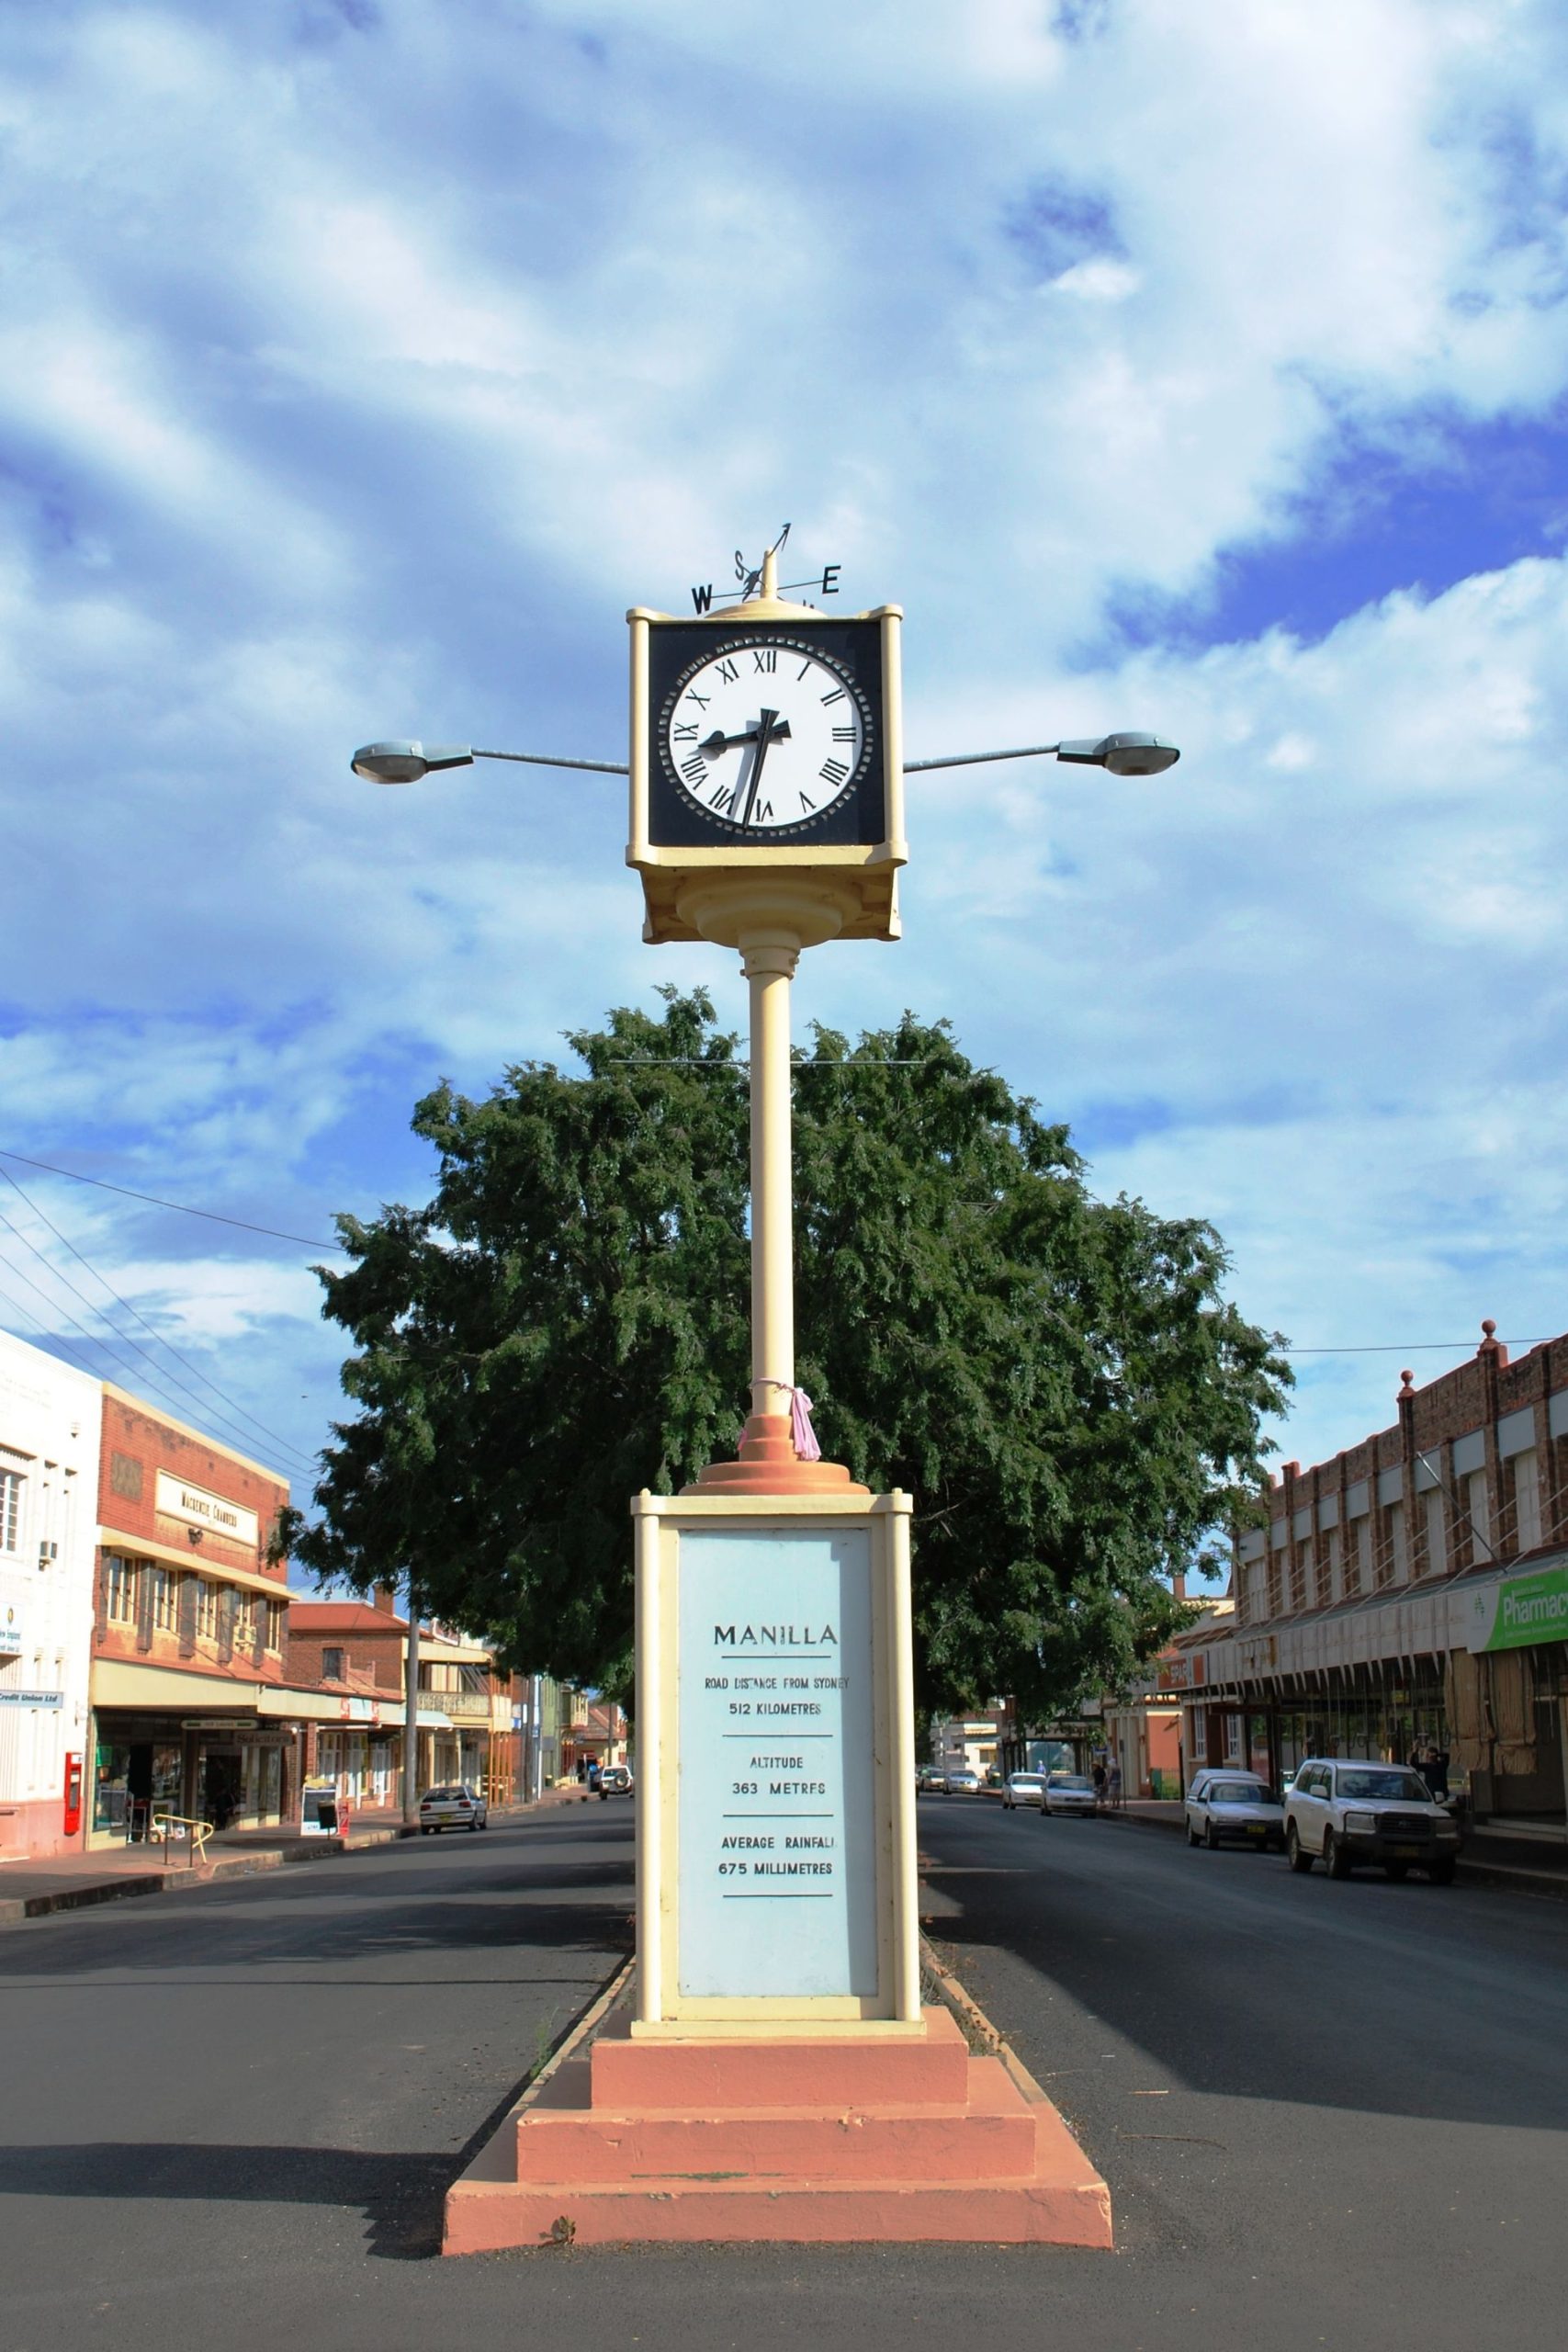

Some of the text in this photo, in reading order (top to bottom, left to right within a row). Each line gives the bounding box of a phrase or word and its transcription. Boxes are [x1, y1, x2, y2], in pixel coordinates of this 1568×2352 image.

[822, 565, 841, 594] E
[691, 583, 713, 615] W
[753, 650, 777, 673] XII
[715, 659, 739, 684] XI
[685, 688, 711, 711] X
[820, 688, 846, 707] II
[674, 722, 699, 741] IX
[831, 727, 857, 743] III
[818, 758, 851, 786] IIII
[799, 791, 817, 813] V
[1504, 1589, 1568, 1626] Pharmac
[714, 1624, 838, 1645] MANILLA
[705, 1677, 850, 1690] ROAD DISTANCE FROM SYDNEY
[45, 1694, 58, 1702] Ltd
[729, 1702, 822, 1715] 512 KILOMETRES
[750, 1757, 804, 1769] ALTITUDE
[732, 1782, 758, 1794] 363
[721, 1837, 774, 1849] AVERAGE
[718, 1862, 833, 1875] 675 MILLIMETRES
